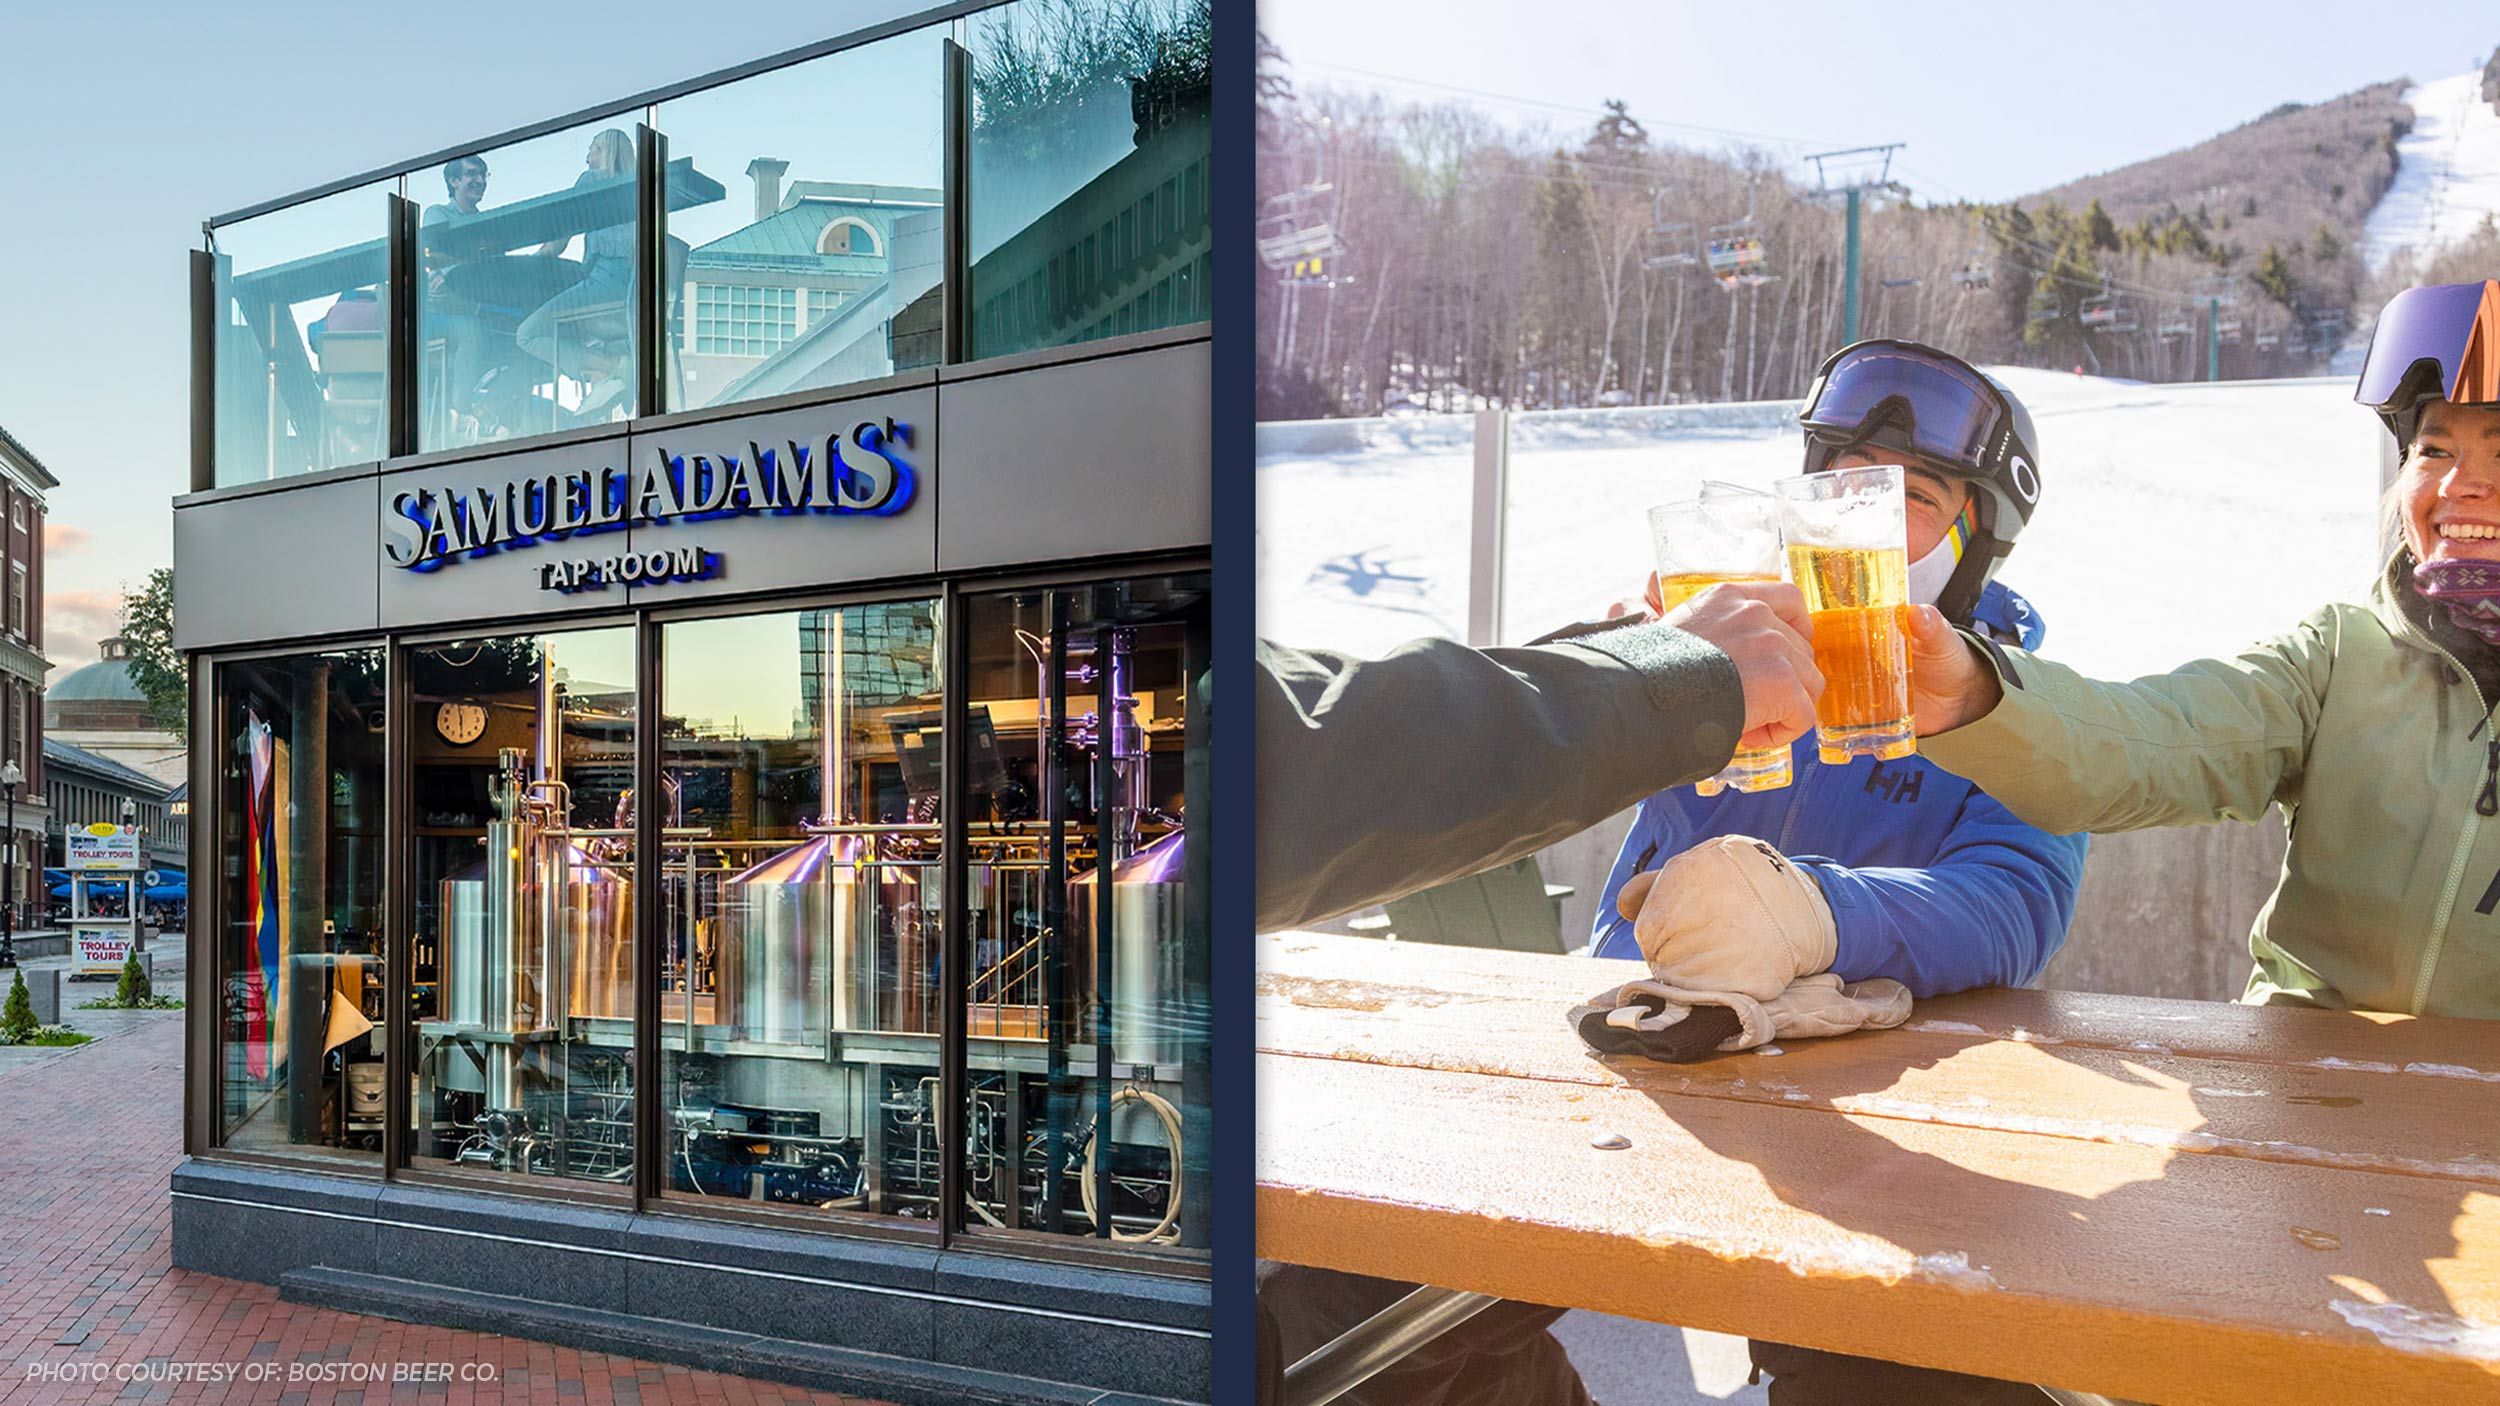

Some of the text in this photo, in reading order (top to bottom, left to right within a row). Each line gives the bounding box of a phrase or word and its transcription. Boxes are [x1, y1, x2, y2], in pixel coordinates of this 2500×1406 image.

[384, 415, 894, 568] SAMUEL ADAMS
[534, 545, 702, 590] TAP ROOM
[73, 850, 133, 858] TROLLEY TOURS
[79, 941, 130, 950] TROLLEY
[85, 952, 123, 960] TOURS
